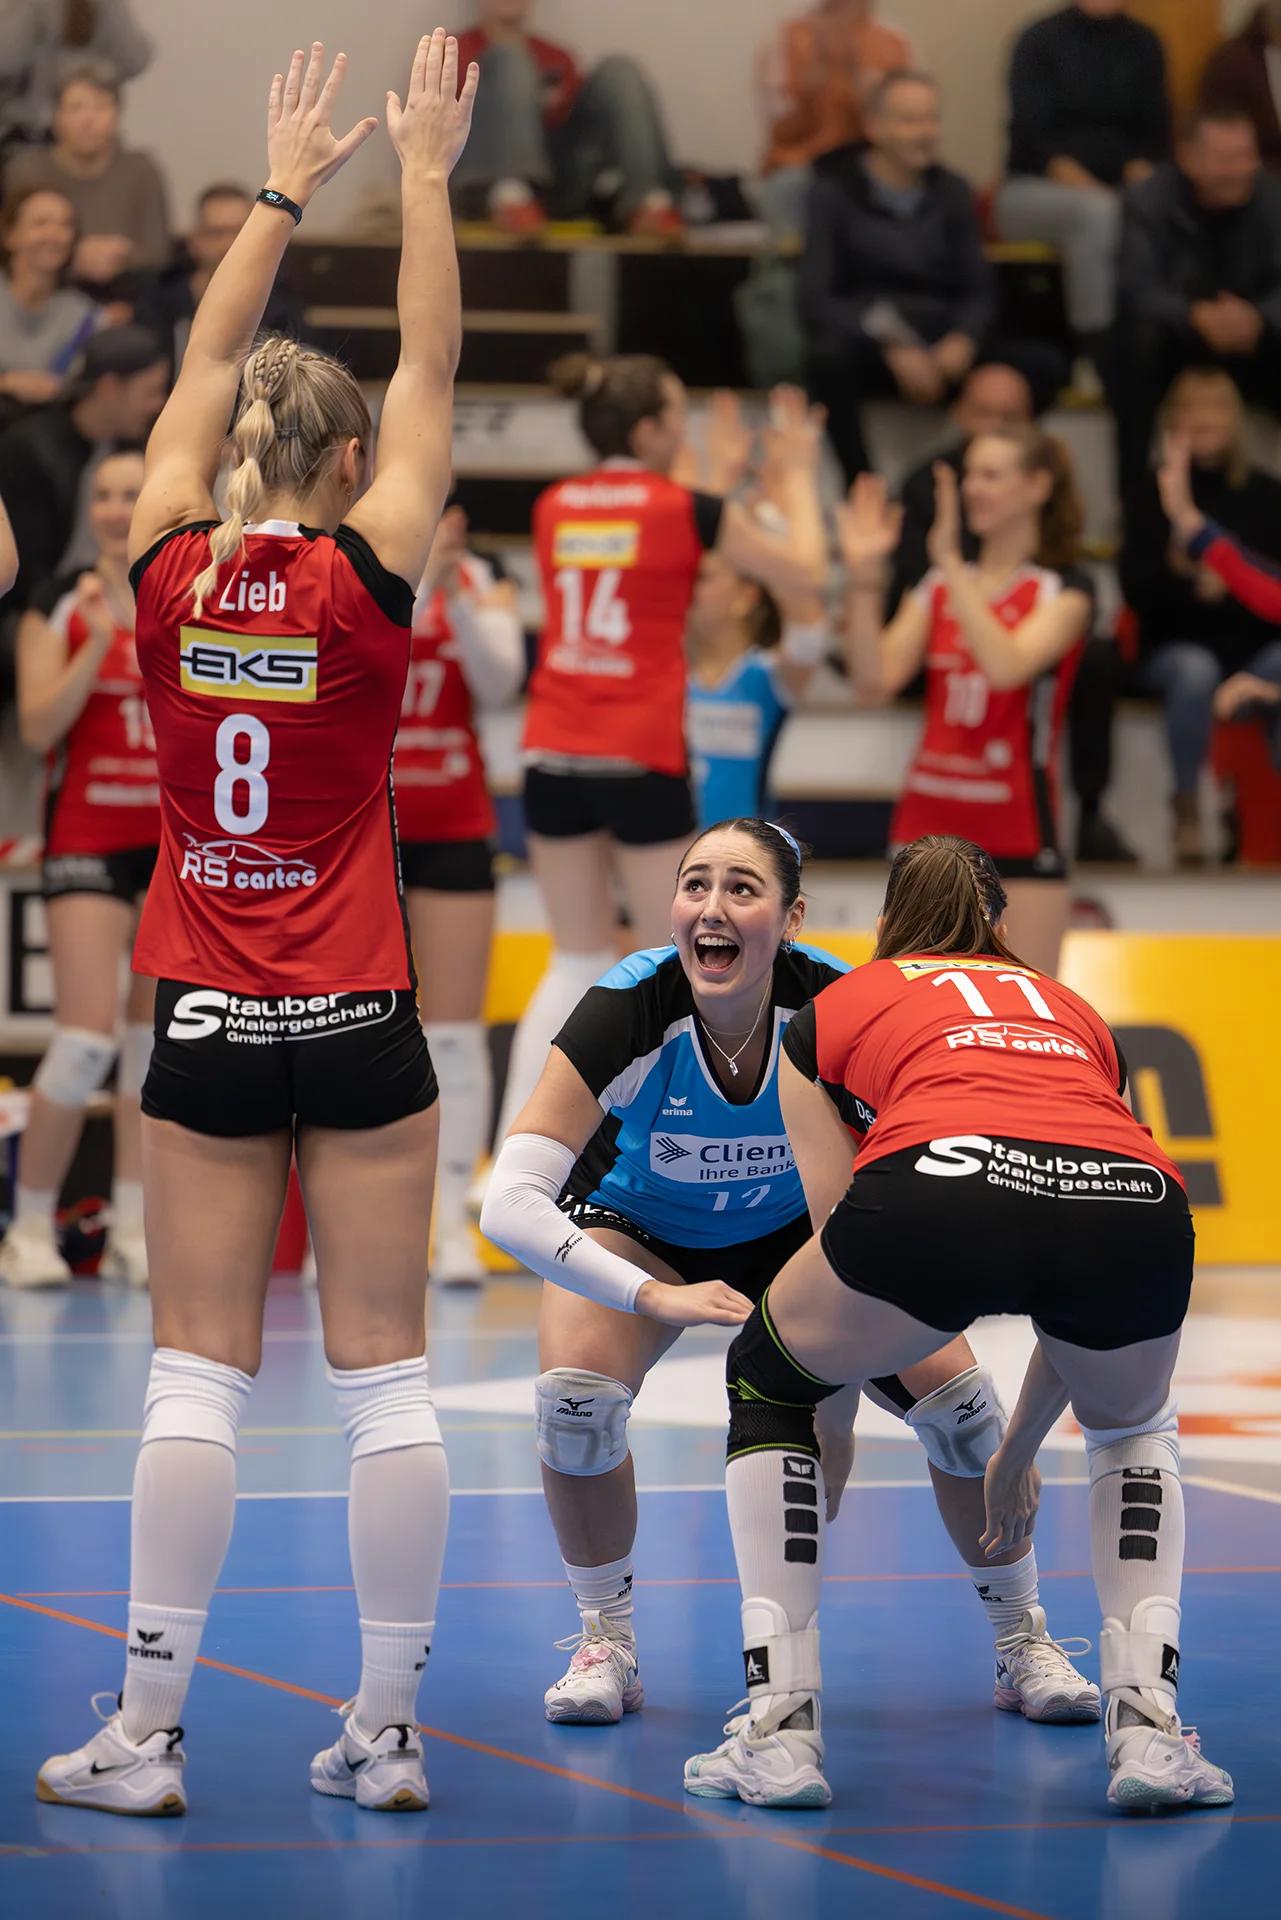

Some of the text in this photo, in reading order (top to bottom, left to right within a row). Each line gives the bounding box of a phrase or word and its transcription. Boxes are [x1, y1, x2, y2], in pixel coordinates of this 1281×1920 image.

[553, 567, 633, 647] 14
[181, 646, 317, 684] EKS
[214, 713, 270, 836] 8
[180, 850, 317, 889] RS cartec
[931, 972, 1056, 1021] 11
[167, 990, 346, 1040] Stauber
[225, 1001, 382, 1034] Malergeschäft
[227, 1030, 273, 1045] GmbH
[946, 1028, 1006, 1049] RS
[662, 1108, 693, 1116] erima
[914, 1135, 1113, 1177] Stauber
[700, 1168, 739, 1180] Ihre
[986, 1173, 1038, 1197] GmbH
[987, 1161, 1153, 1193] Malergeschäft
